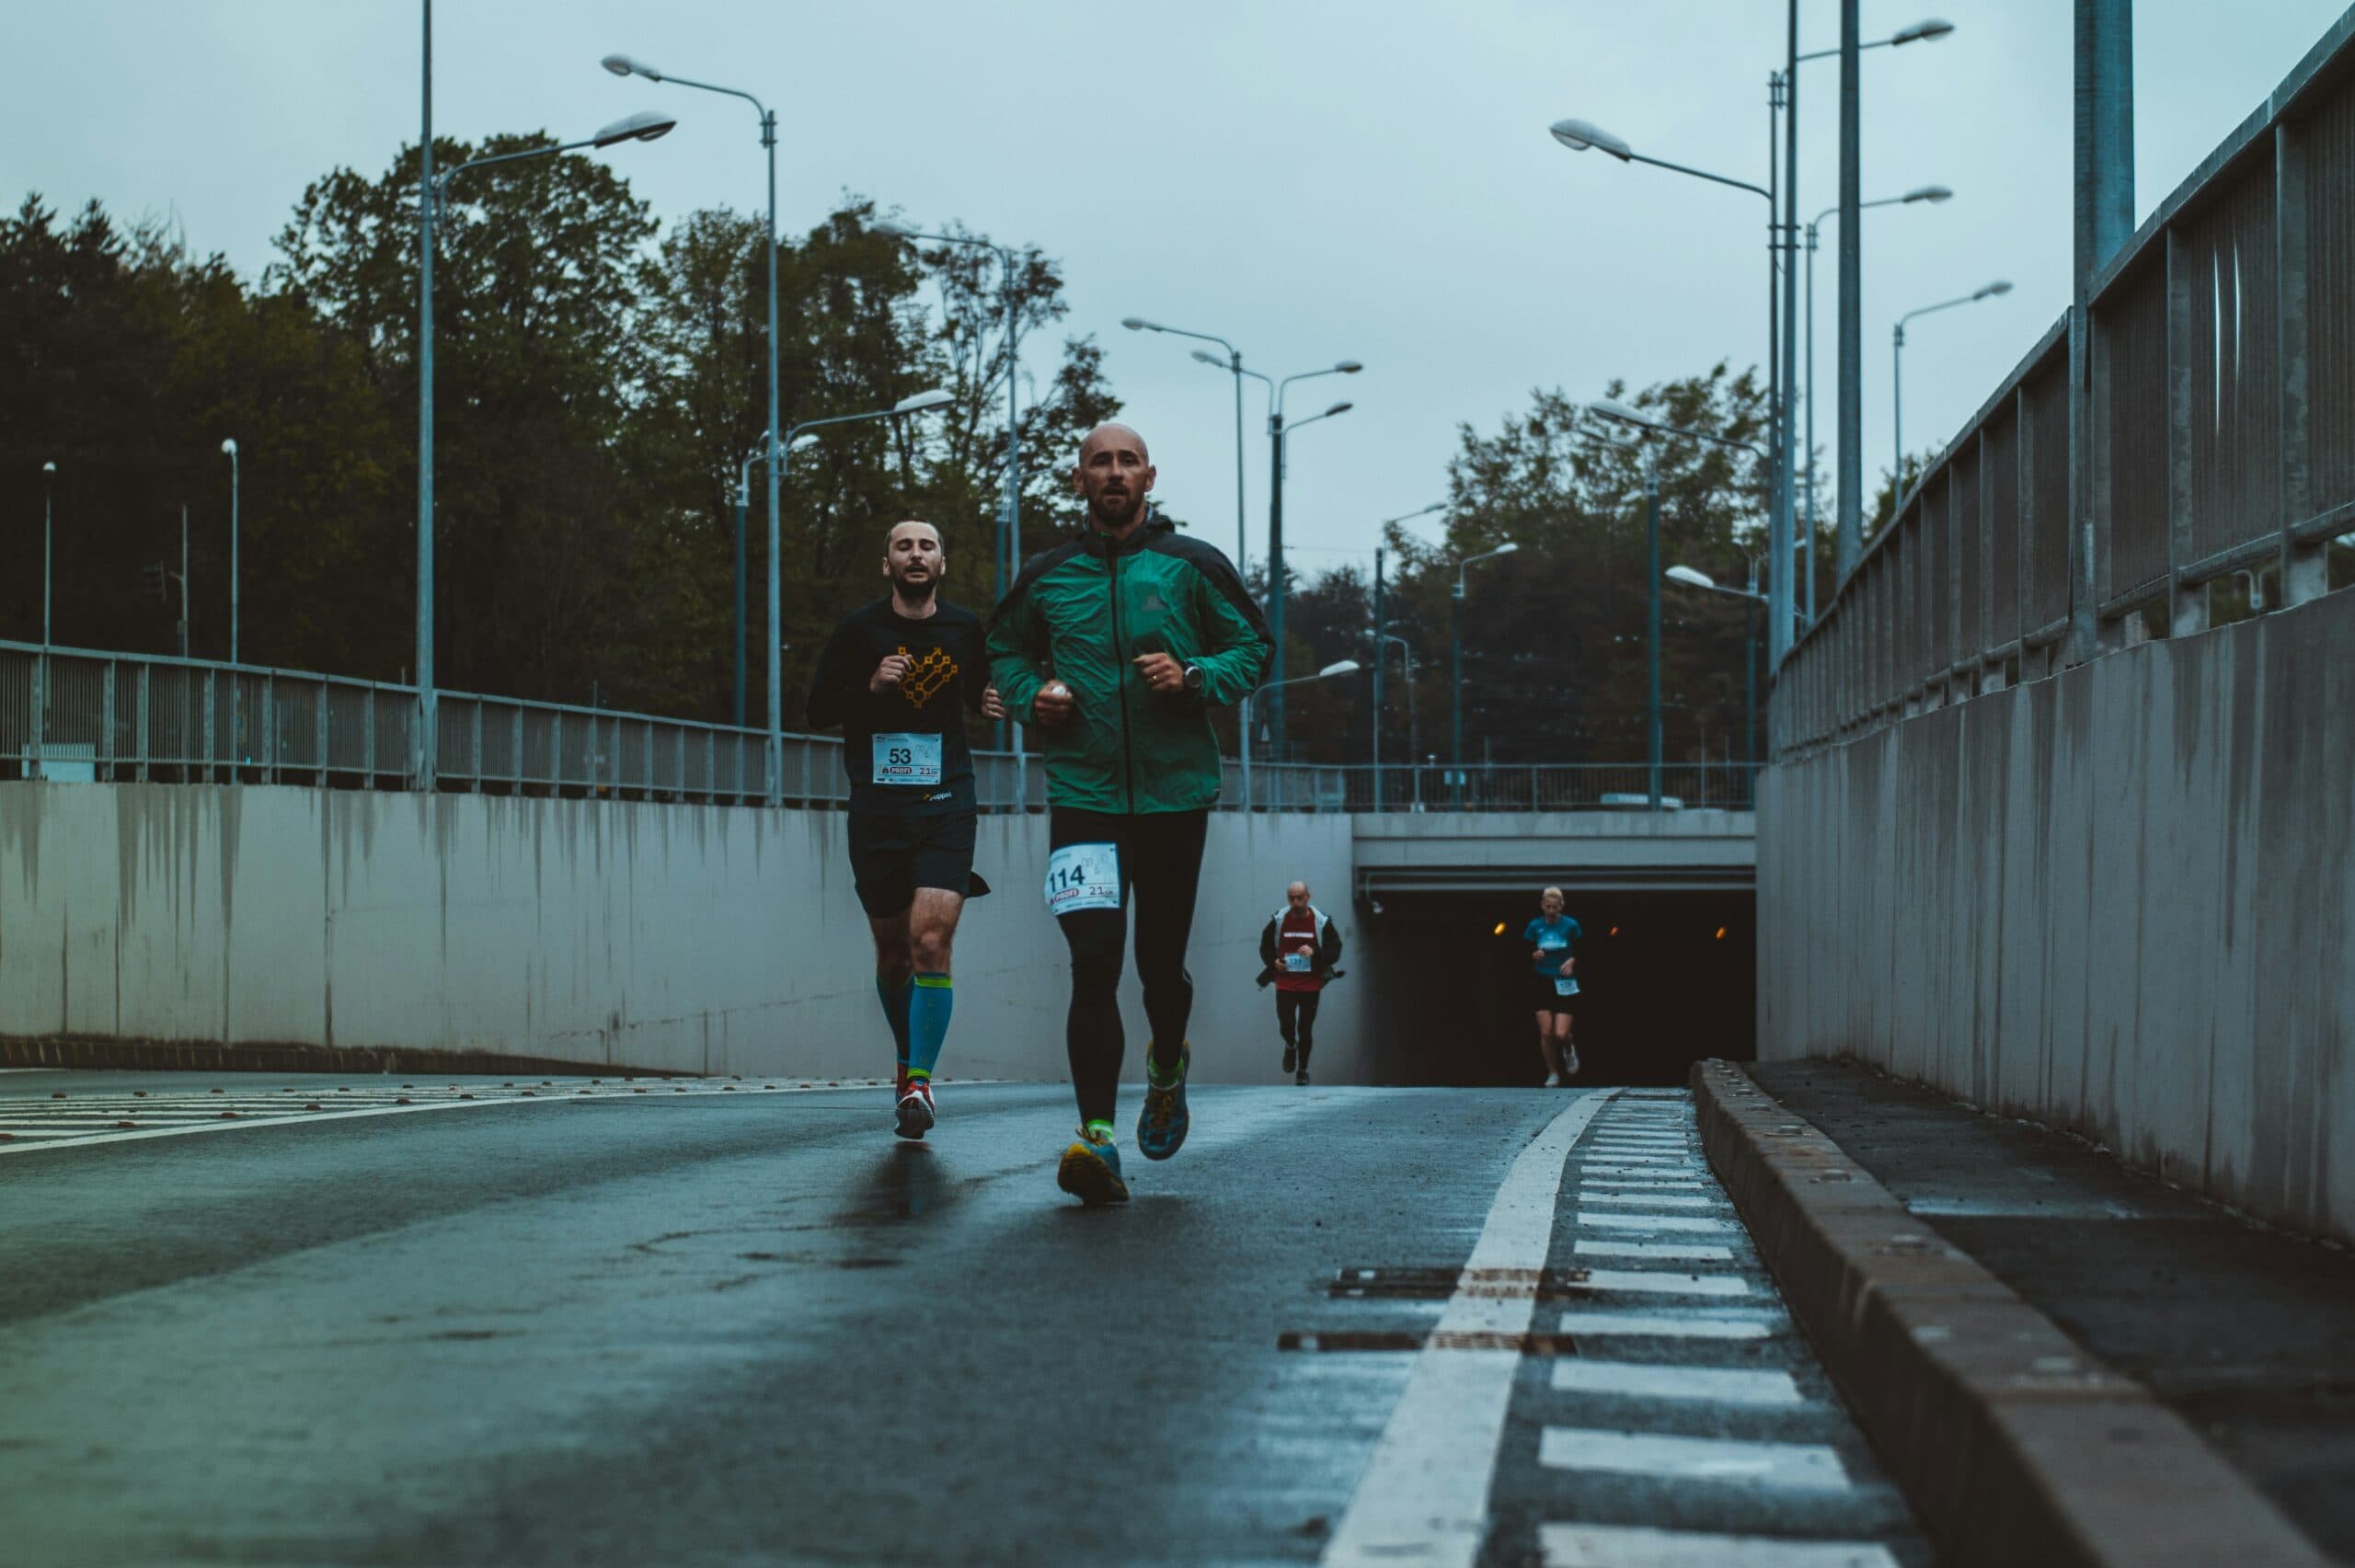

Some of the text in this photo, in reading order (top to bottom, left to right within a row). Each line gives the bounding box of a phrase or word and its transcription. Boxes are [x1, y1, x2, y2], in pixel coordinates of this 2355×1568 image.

[889, 748, 912, 764] 53
[1049, 864, 1085, 892] 114
[1055, 888, 1077, 901] PROFI
